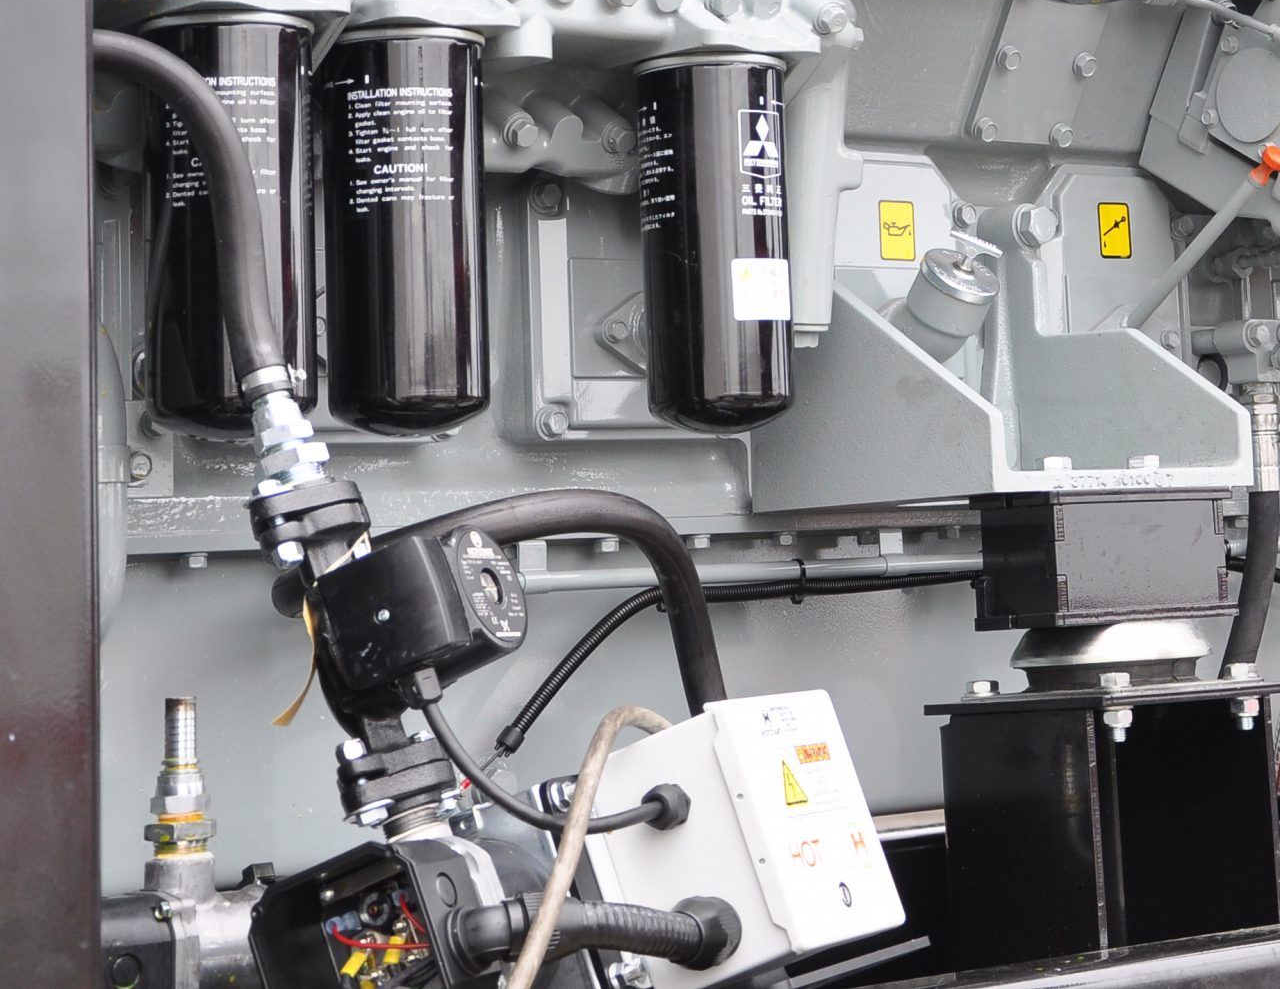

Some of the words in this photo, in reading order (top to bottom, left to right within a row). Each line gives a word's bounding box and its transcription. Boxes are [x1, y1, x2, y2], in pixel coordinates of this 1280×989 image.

[219, 76, 276, 87] INSTRUCTIONS
[347, 88, 397, 101] INSTALLATION
[400, 87, 453, 98] INSTRUCTIONS
[355, 111, 370, 119] Apply
[356, 129, 378, 137] Tighten
[372, 137, 395, 145] gasket
[374, 163, 428, 175] CAUTION!
[356, 187, 382, 195] changing
[356, 196, 378, 204] Dented
[741, 195, 757, 206] OIL
[759, 195, 782, 207] FILTER
